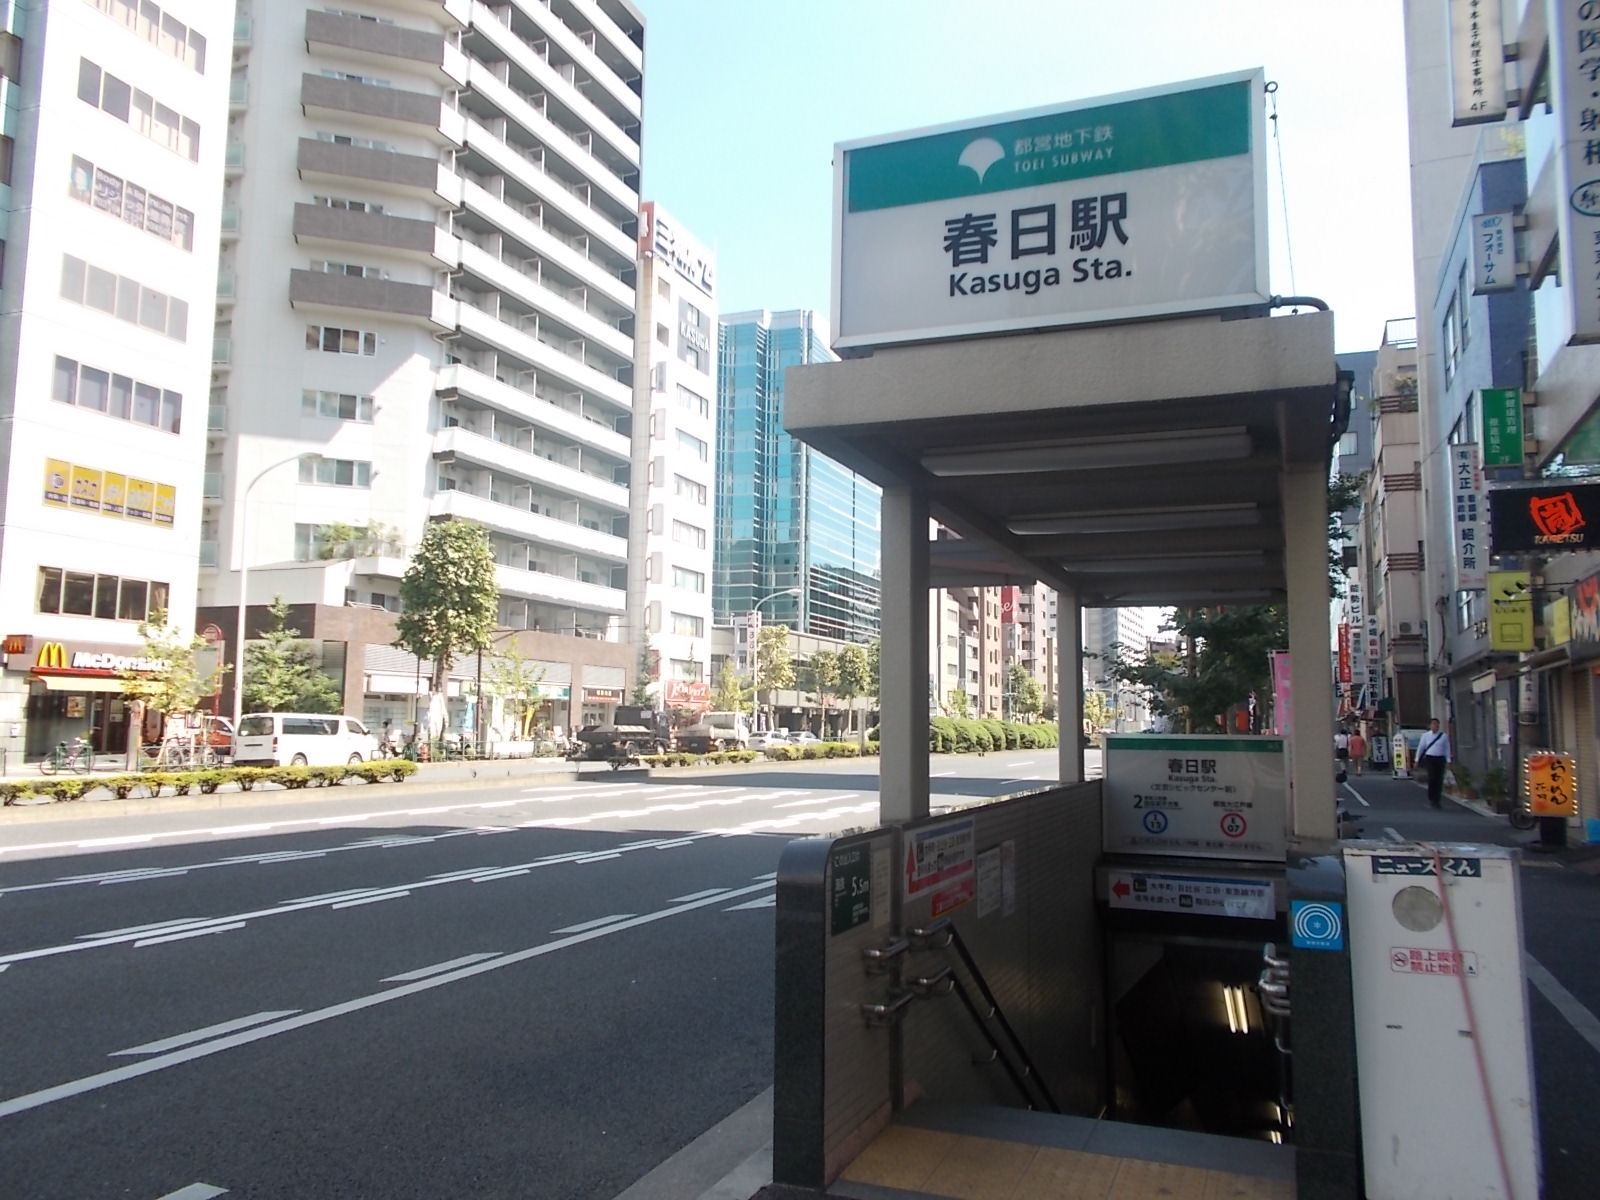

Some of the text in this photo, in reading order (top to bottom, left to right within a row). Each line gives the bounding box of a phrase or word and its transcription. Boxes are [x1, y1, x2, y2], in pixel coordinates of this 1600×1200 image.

[1013, 125, 1115, 157] 都営地下鉄
[1013, 147, 1115, 174] TOEI SUBWAY
[943, 192, 1129, 268] 春日駅
[949, 257, 1133, 298] Kasuga Sta.
[679, 321, 711, 353] KASUGA
[1168, 758, 1217, 774] 春日駅
[1168, 774, 1200, 783] Kasuga
[1133, 795, 1143, 809] 2
[1377, 858, 1477, 876] ニュースくん
